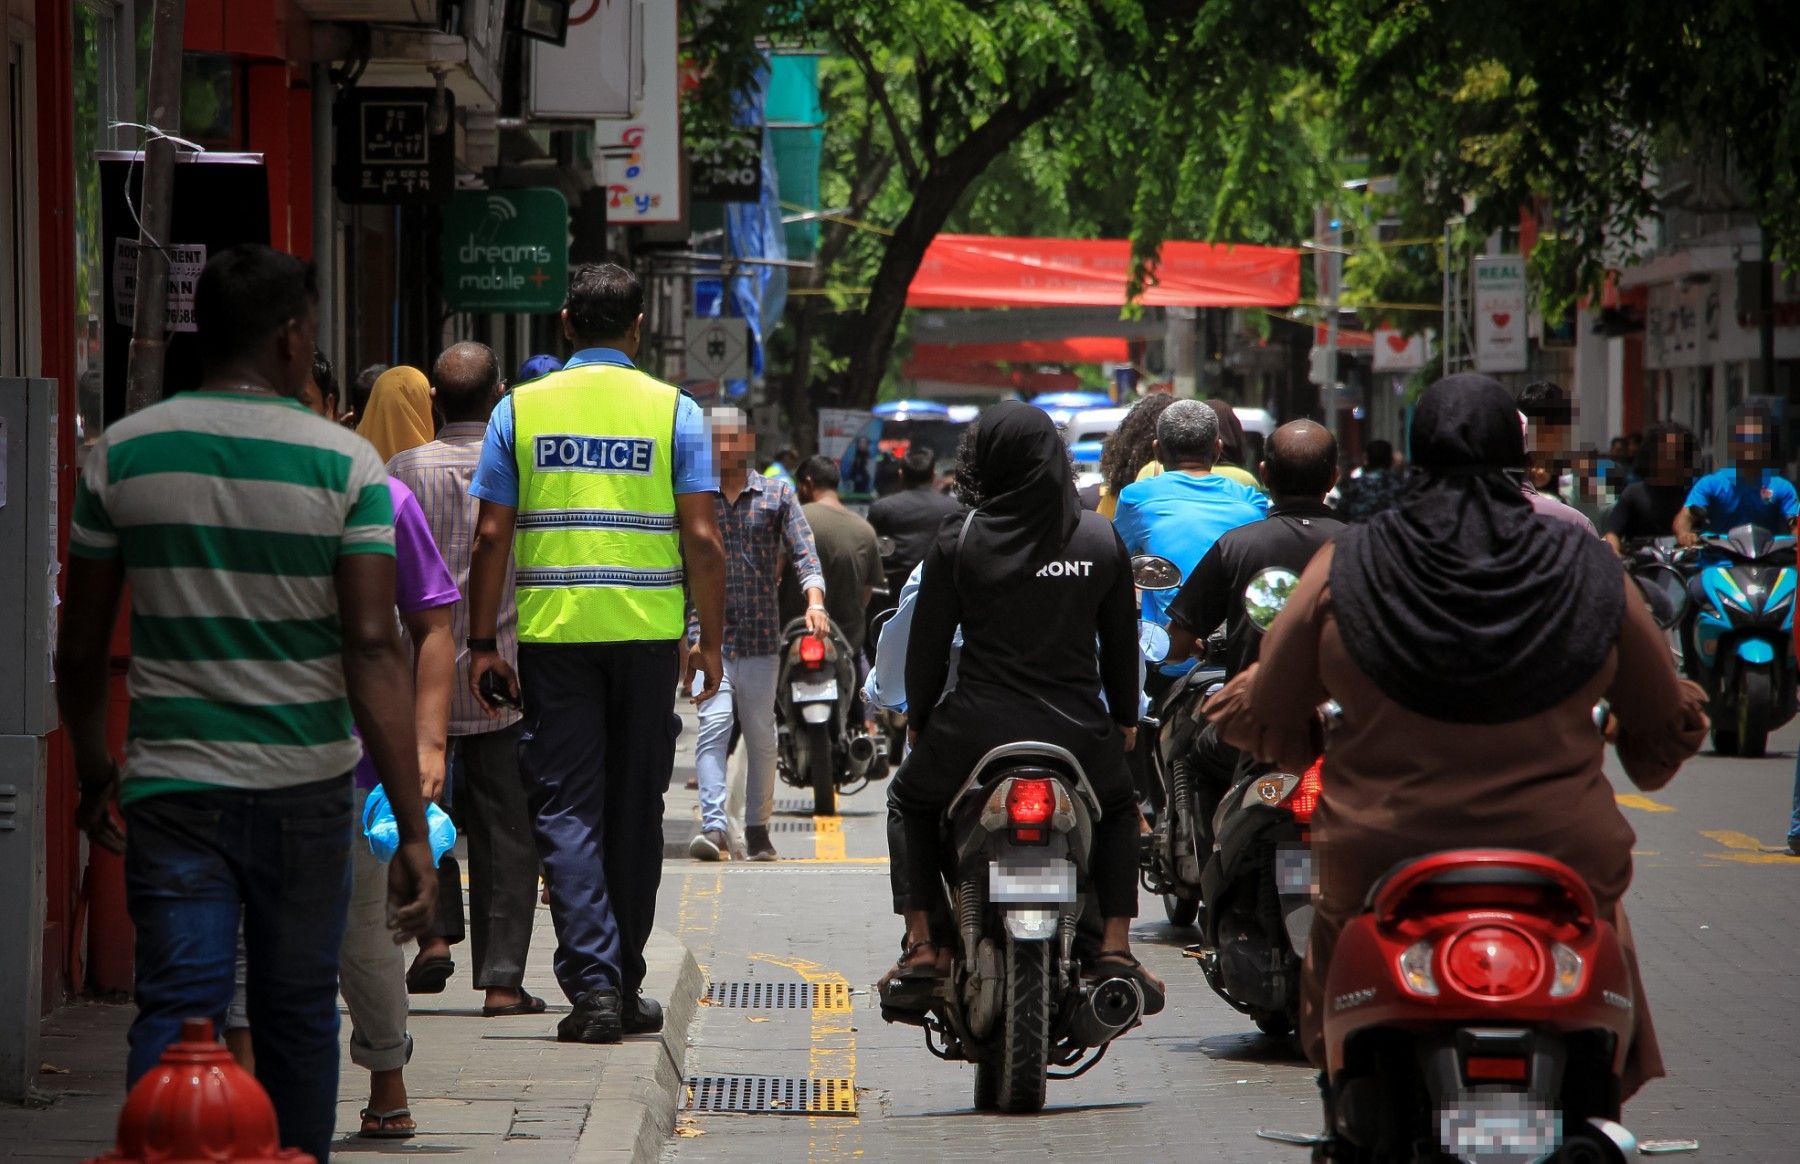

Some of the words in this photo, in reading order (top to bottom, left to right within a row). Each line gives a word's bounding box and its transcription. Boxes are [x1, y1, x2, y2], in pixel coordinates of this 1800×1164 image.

[608, 184, 662, 214] Toys
[170, 250, 202, 263] RENT
[459, 232, 551, 263] dreams
[459, 266, 526, 290] mobile
[1477, 266, 1521, 279] REAL
[539, 438, 649, 469] POLICE
